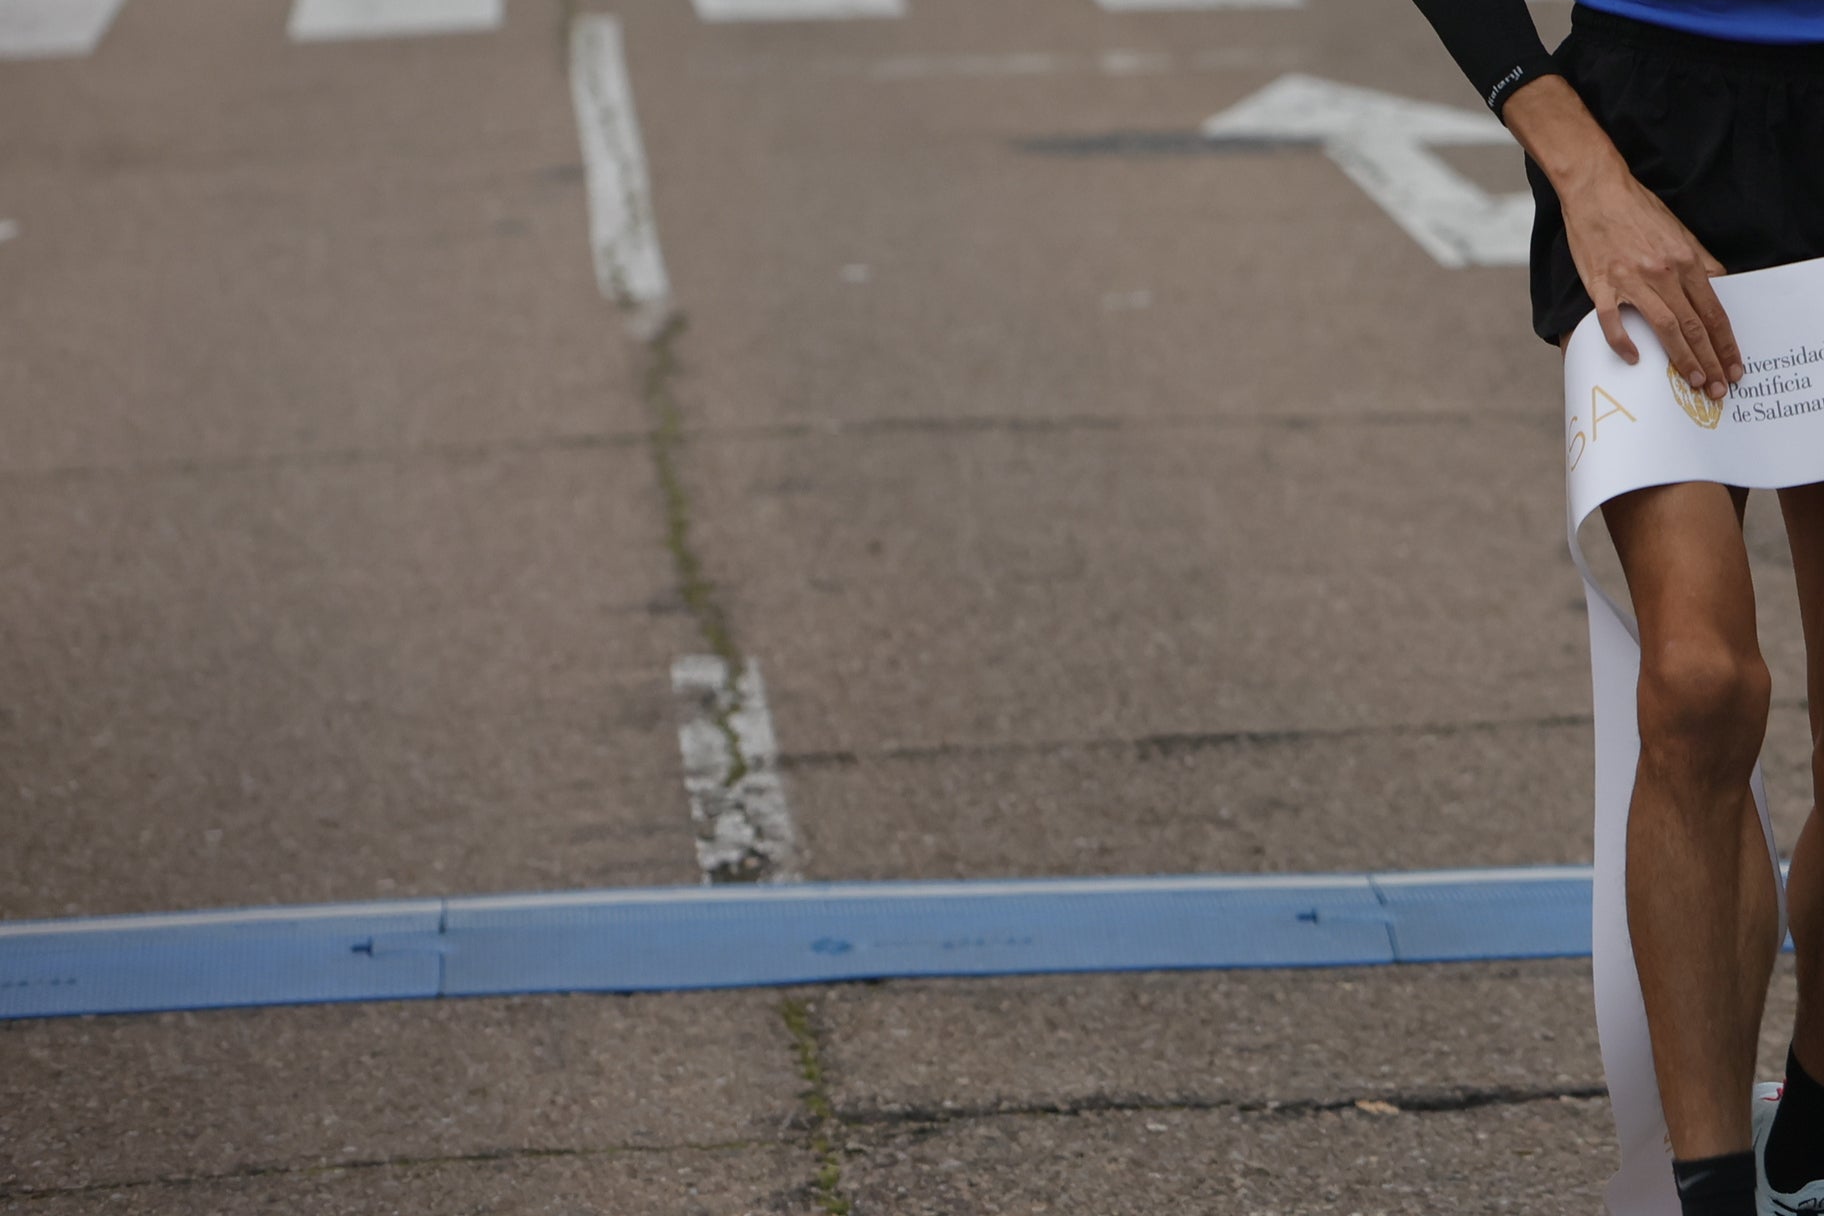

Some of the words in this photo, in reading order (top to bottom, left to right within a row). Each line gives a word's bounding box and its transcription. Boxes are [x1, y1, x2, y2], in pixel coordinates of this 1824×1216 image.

[1727, 374, 1812, 399] Pontificia
[1732, 405, 1752, 423] de
[1568, 384, 1637, 472] SA
